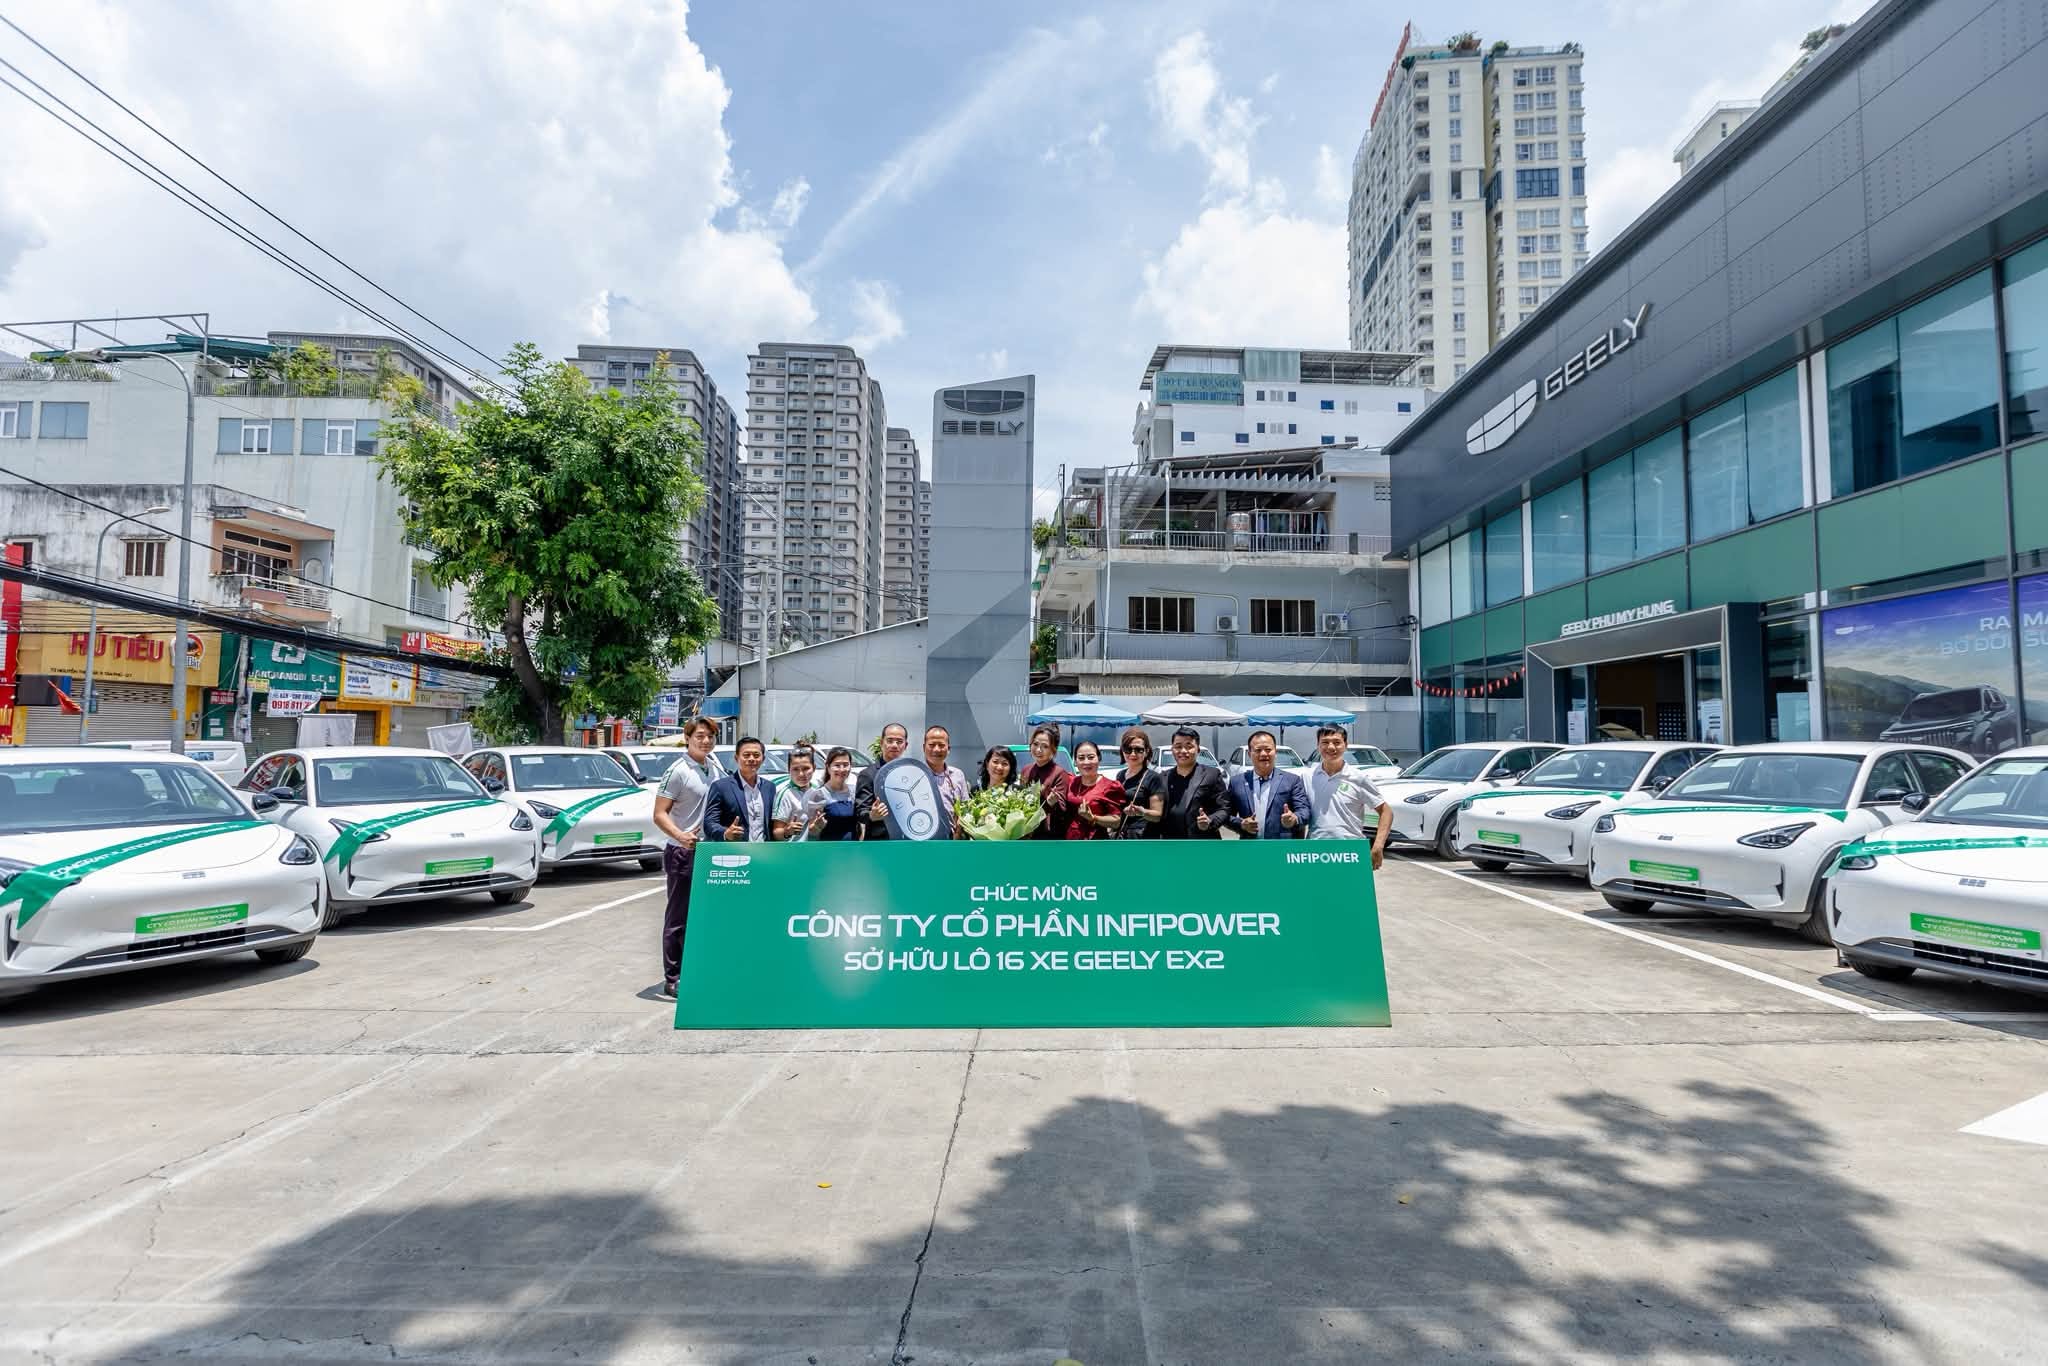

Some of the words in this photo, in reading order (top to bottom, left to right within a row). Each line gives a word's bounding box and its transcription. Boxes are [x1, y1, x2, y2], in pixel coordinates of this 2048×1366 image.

[1544, 303, 1652, 400] GEELY
[942, 420, 1024, 436] GEELY
[1561, 618, 1592, 637] GEELY
[1980, 615, 2011, 632] RA
[1286, 852, 1360, 864] INFIPOWER
[709, 870, 750, 878] GEELY
[970, 883, 1028, 901] CHÚC
[1032, 883, 1098, 901] MỪNG
[787, 909, 882, 938] CÔNG
[887, 914, 937, 938] TY
[942, 907, 989, 938] CỔ
[995, 908, 1089, 937] PHẦN
[1096, 912, 1281, 937] INFIPOWER
[843, 947, 884, 971] SỞ
[888, 947, 948, 971] HỮU
[954, 947, 991, 971] LÔ
[996, 951, 1025, 971] 16
[1030, 950, 1069, 970] XE
[1074, 950, 1161, 970] GEELY
[1166, 950, 1225, 970] EX2
